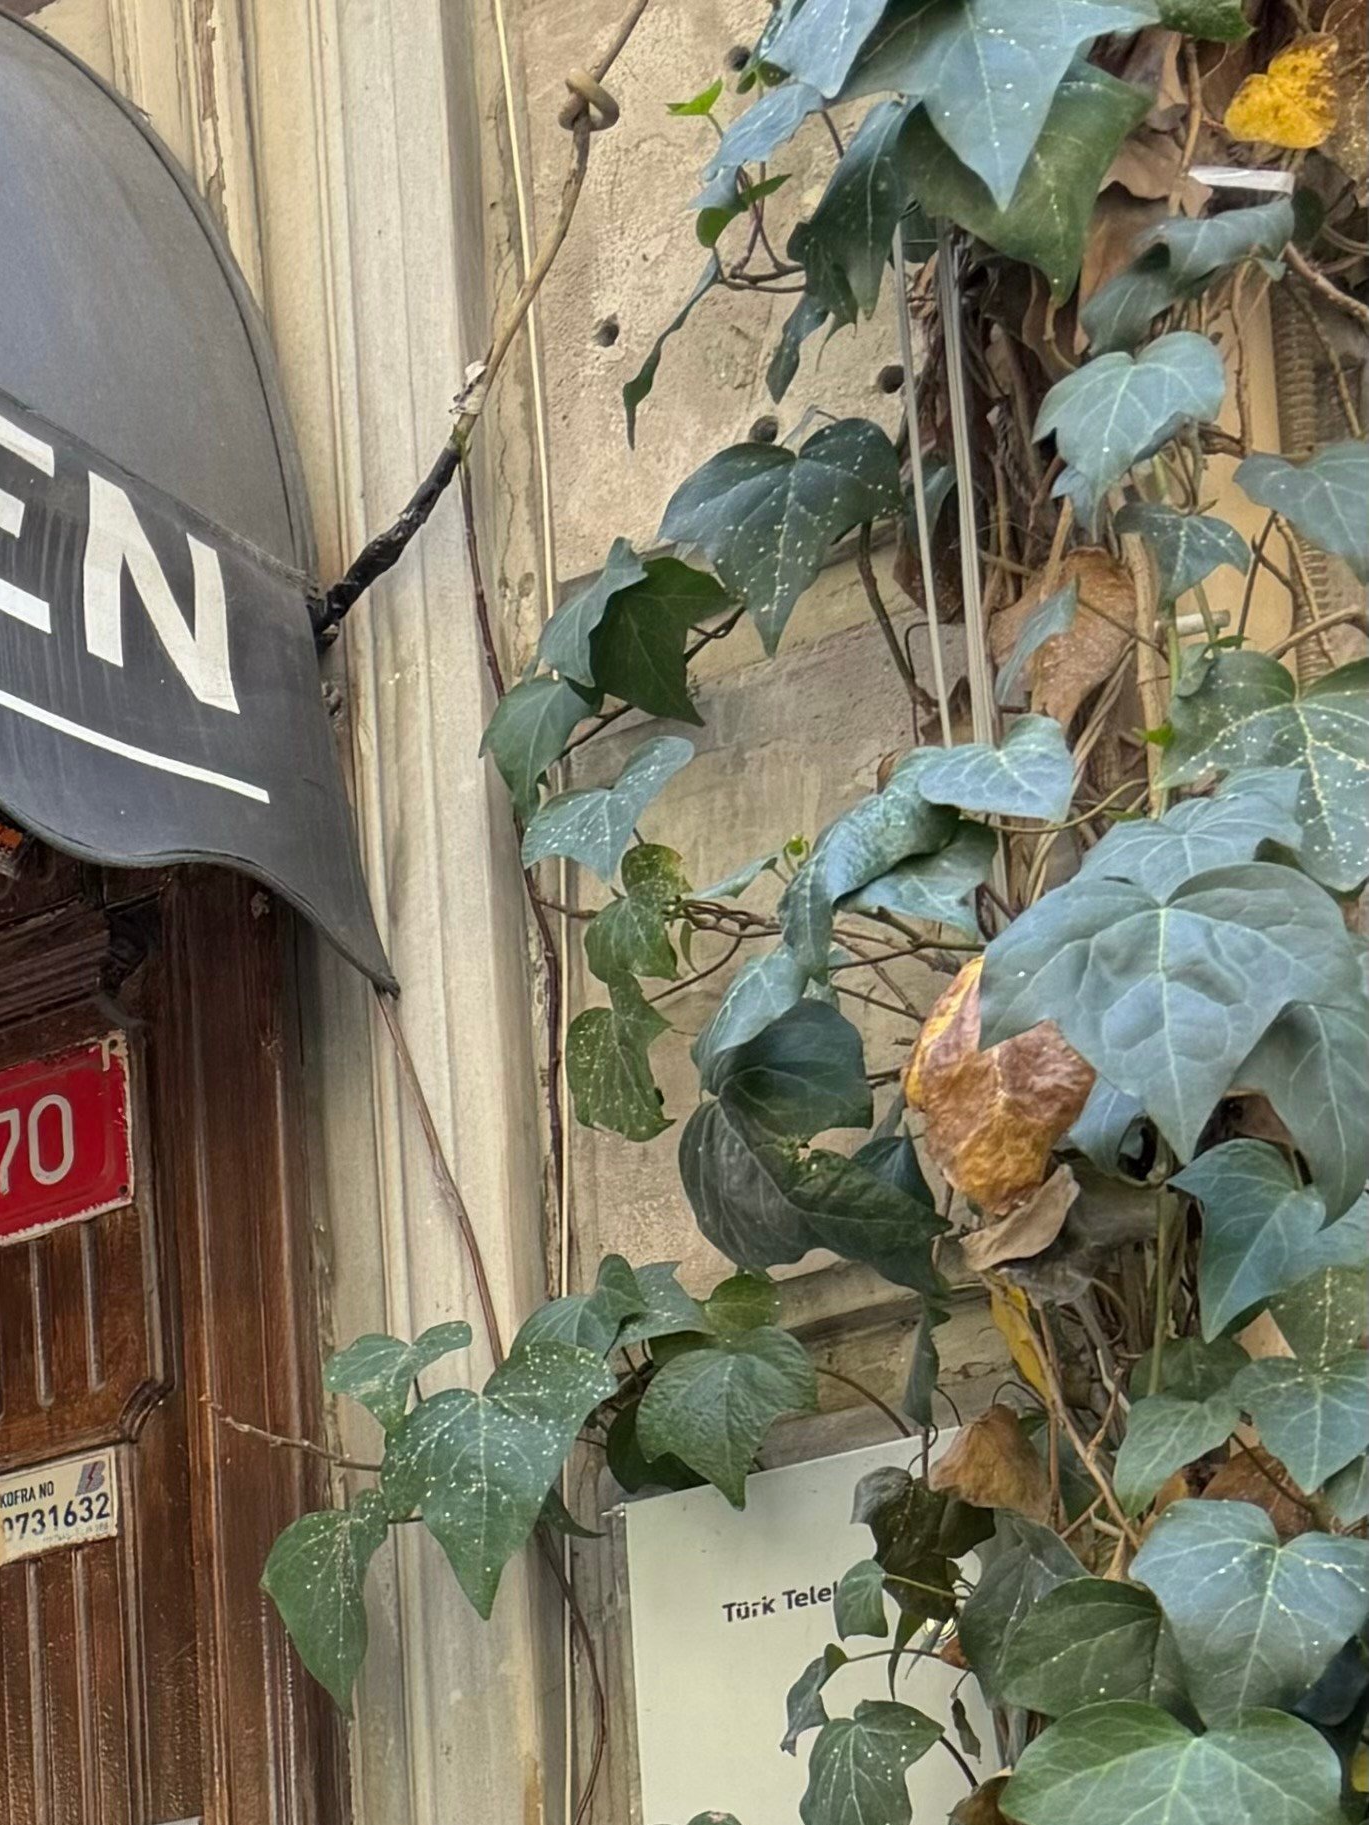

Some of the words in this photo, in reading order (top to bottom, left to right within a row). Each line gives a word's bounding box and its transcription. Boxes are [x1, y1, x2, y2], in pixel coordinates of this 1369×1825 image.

[0, 1486, 37, 1509] KOFRA
[39, 1480, 55, 1499] NO
[721, 1594, 776, 1623] Türk
